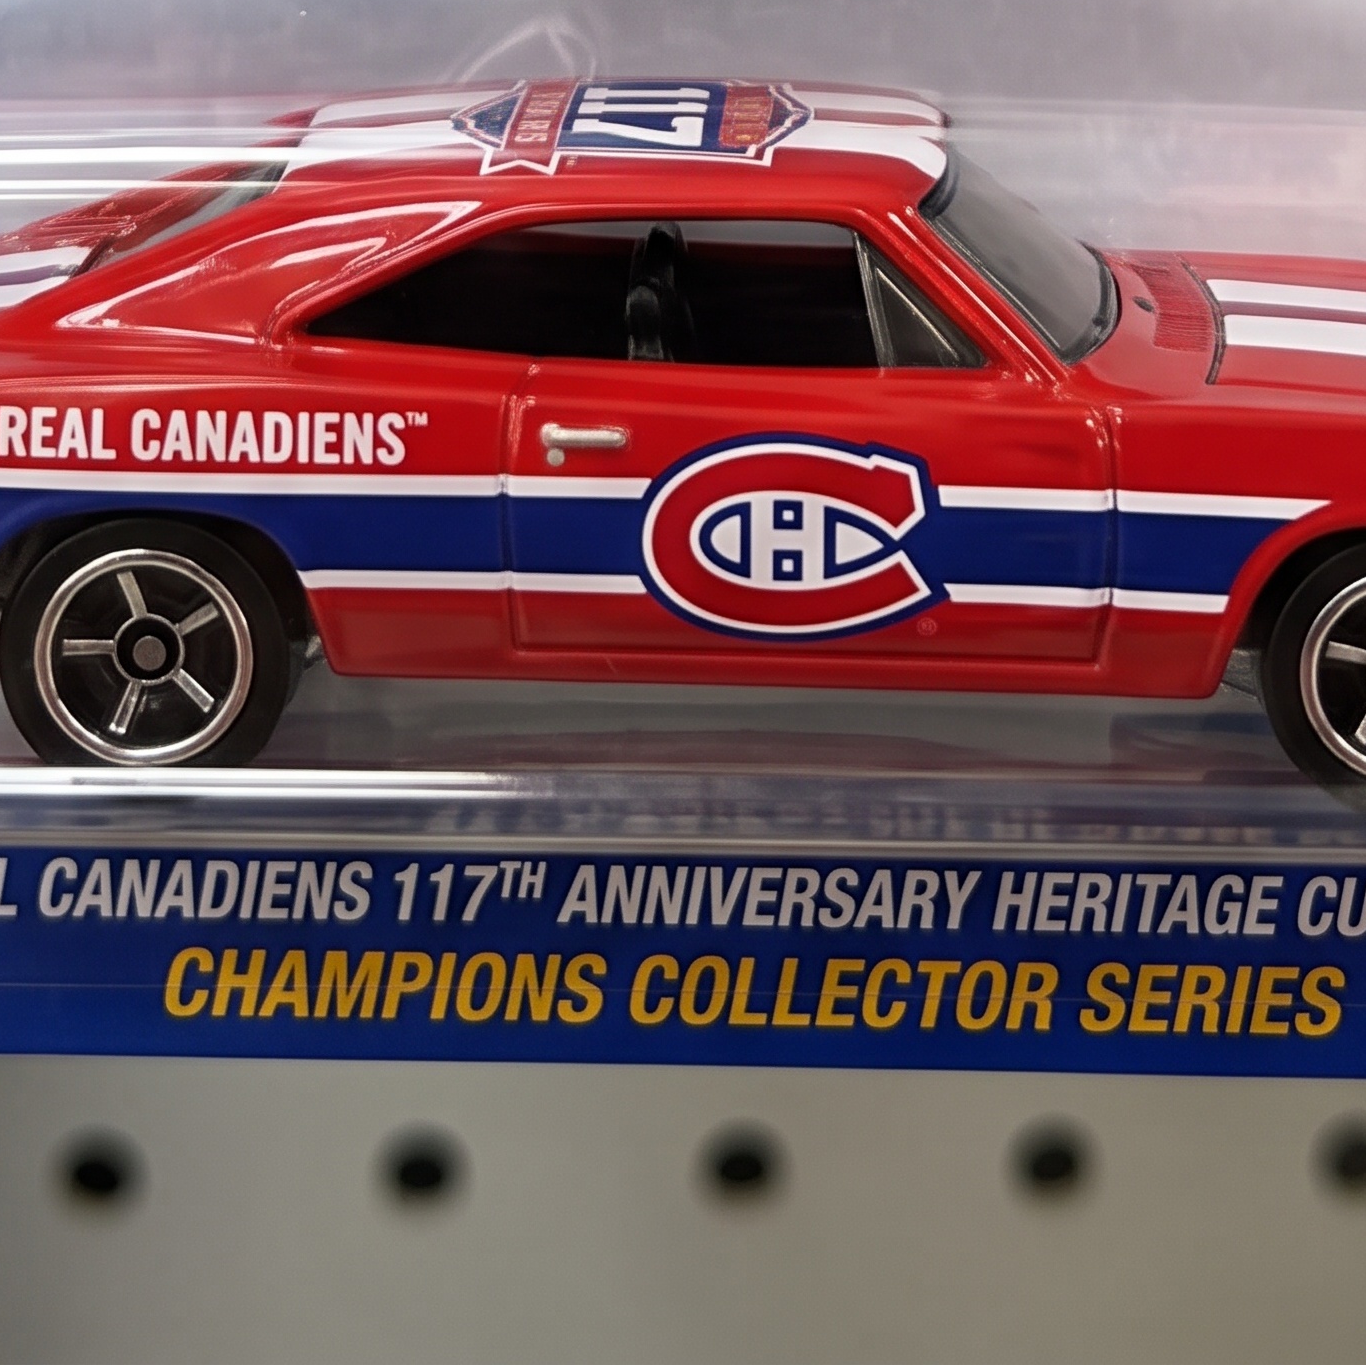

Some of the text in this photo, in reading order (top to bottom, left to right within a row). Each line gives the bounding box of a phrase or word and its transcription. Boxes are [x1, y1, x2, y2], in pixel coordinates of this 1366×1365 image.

[36, 856, 376, 922] CANADIENS
[394, 859, 545, 925] 117TH
[557, 863, 978, 931] ANNIVERSARY
[991, 871, 1285, 937] HERITAGE
[163, 946, 1347, 1038] CHAMPIONS COLLECTOR SERIES
